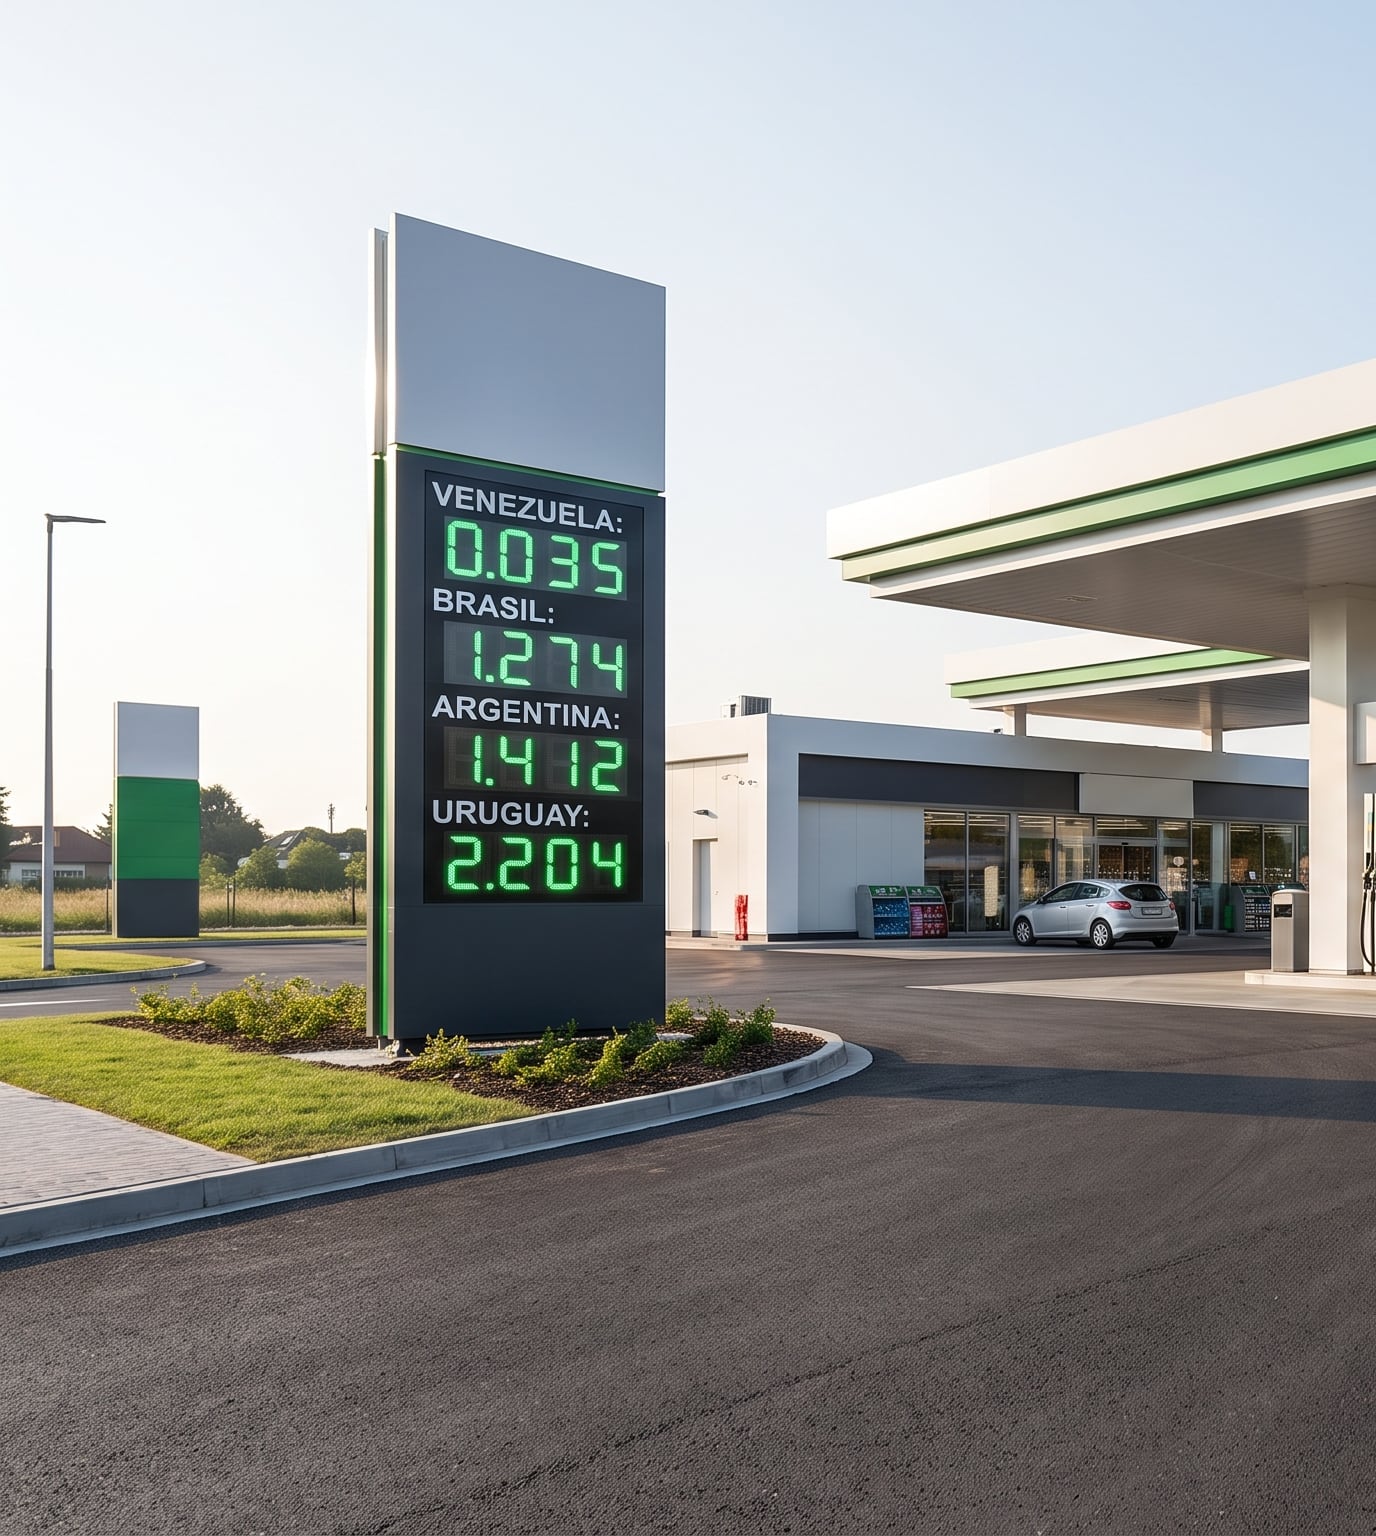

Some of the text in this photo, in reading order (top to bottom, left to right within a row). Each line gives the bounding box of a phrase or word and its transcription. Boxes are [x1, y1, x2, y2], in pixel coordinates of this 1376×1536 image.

[432, 481, 623, 533] VENEZUELA:
[446, 520, 623, 595] 0.035
[433, 587, 555, 624] BRASIL:
[473, 630, 624, 692] 1.274
[431, 695, 620, 730] ARGENTINA:
[473, 735, 623, 793] 1.412
[432, 800, 590, 828] URUGUAY:
[447, 835, 622, 890] 2.204
